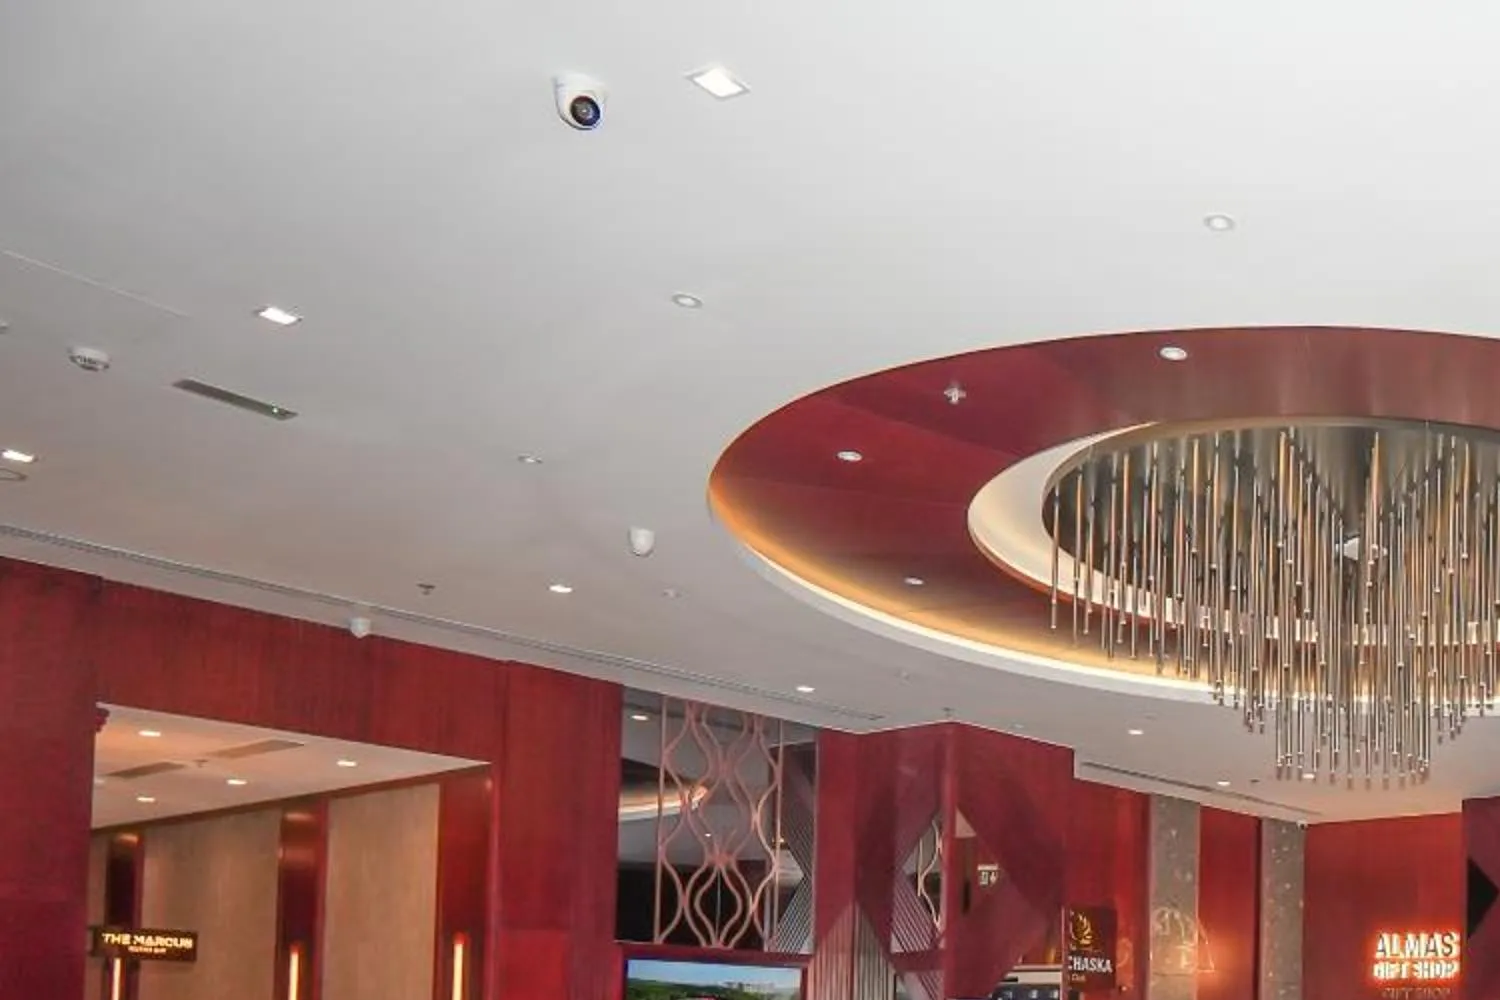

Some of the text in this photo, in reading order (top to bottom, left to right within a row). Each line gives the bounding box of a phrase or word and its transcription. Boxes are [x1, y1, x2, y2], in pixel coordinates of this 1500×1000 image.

[102, 933, 130, 945] THE
[1375, 931, 1460, 959] ALMAS
[1373, 960, 1460, 980] GIFT SHOP
